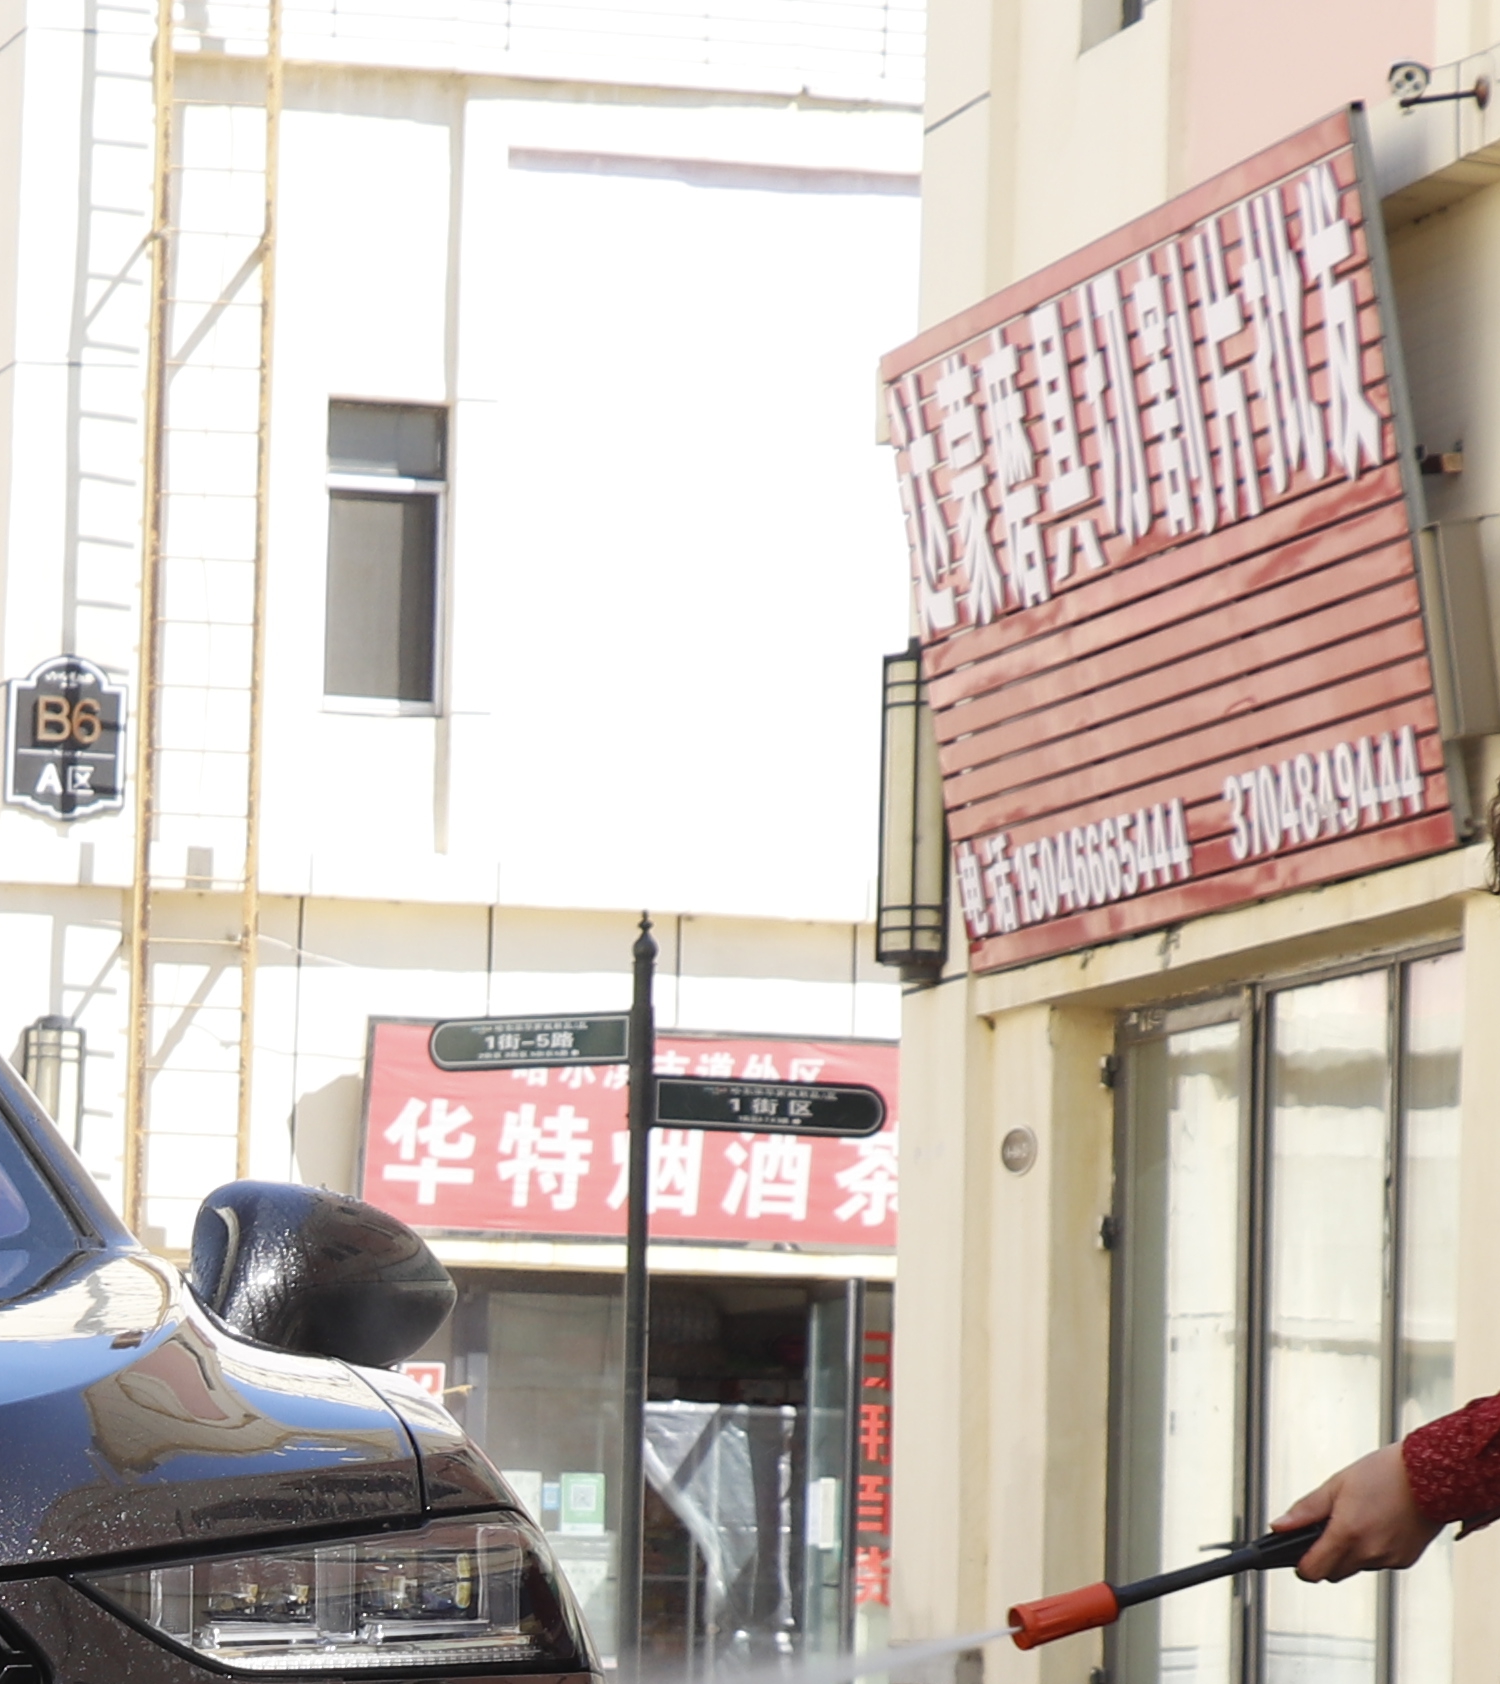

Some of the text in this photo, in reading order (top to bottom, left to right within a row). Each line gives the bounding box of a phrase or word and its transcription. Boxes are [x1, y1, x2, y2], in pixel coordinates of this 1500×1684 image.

[37, 696, 102, 744] B6
[36, 763, 95, 795] A区
[1222, 724, 1426, 861] 3704849444
